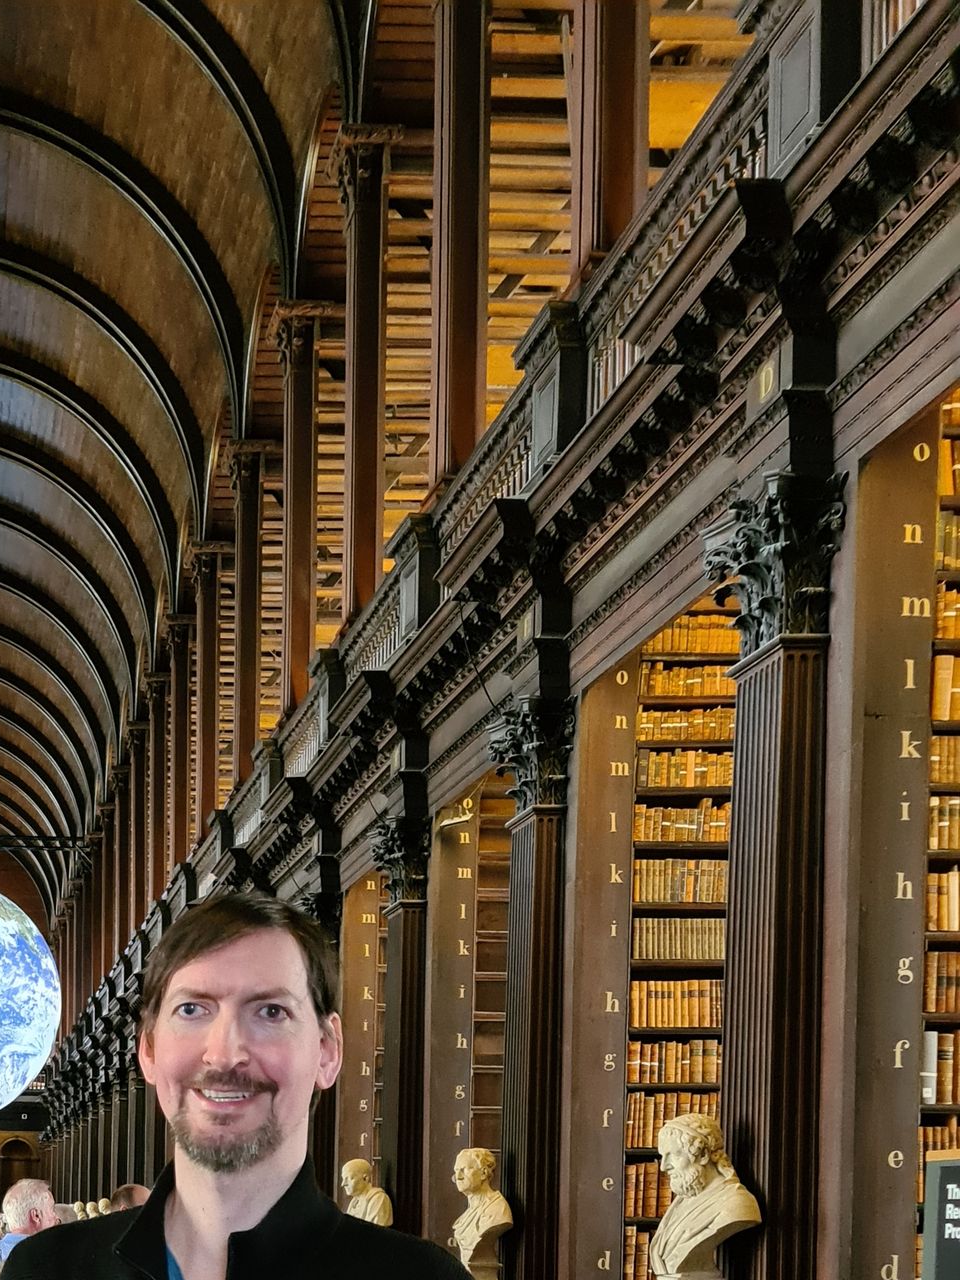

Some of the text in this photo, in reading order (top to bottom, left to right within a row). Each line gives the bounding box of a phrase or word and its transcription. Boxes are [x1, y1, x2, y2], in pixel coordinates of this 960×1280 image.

[913, 443, 930, 462] o
[904, 523, 923, 544] n
[901, 596, 930, 617] m
[616, 671, 628, 685] o
[904, 659, 916, 689] l
[615, 715, 628, 729] n
[899, 731, 922, 758] k
[610, 761, 629, 776] m
[463, 798, 473, 809] o
[900, 791, 910, 821] i
[609, 812, 617, 833] l
[460, 832, 470, 843] n
[457, 867, 472, 879] m
[609, 864, 624, 883] k
[366, 880, 376, 890] n
[895, 872, 913, 899] h
[362, 913, 376, 924] m
[610, 920, 617, 937] i
[458, 940, 470, 955] k
[897, 957, 913, 984] g
[363, 987, 374, 1000] k
[459, 985, 466, 999] i
[605, 992, 619, 1012] h
[363, 1019, 368, 1031] i
[456, 1033, 468, 1049] h
[893, 1040, 910, 1068] f
[361, 1062, 370, 1076] h
[603, 1054, 616, 1071] g
[455, 1085, 466, 1099] g
[359, 1099, 368, 1112] g
[602, 1109, 613, 1128] f
[455, 1120, 464, 1136] f
[360, 1133, 368, 1147] f
[888, 1150, 904, 1168] e
[602, 1176, 614, 1191] e
[945, 1203, 960, 1220] Re
[598, 1252, 610, 1270] d
[880, 1256, 899, 1280] d
